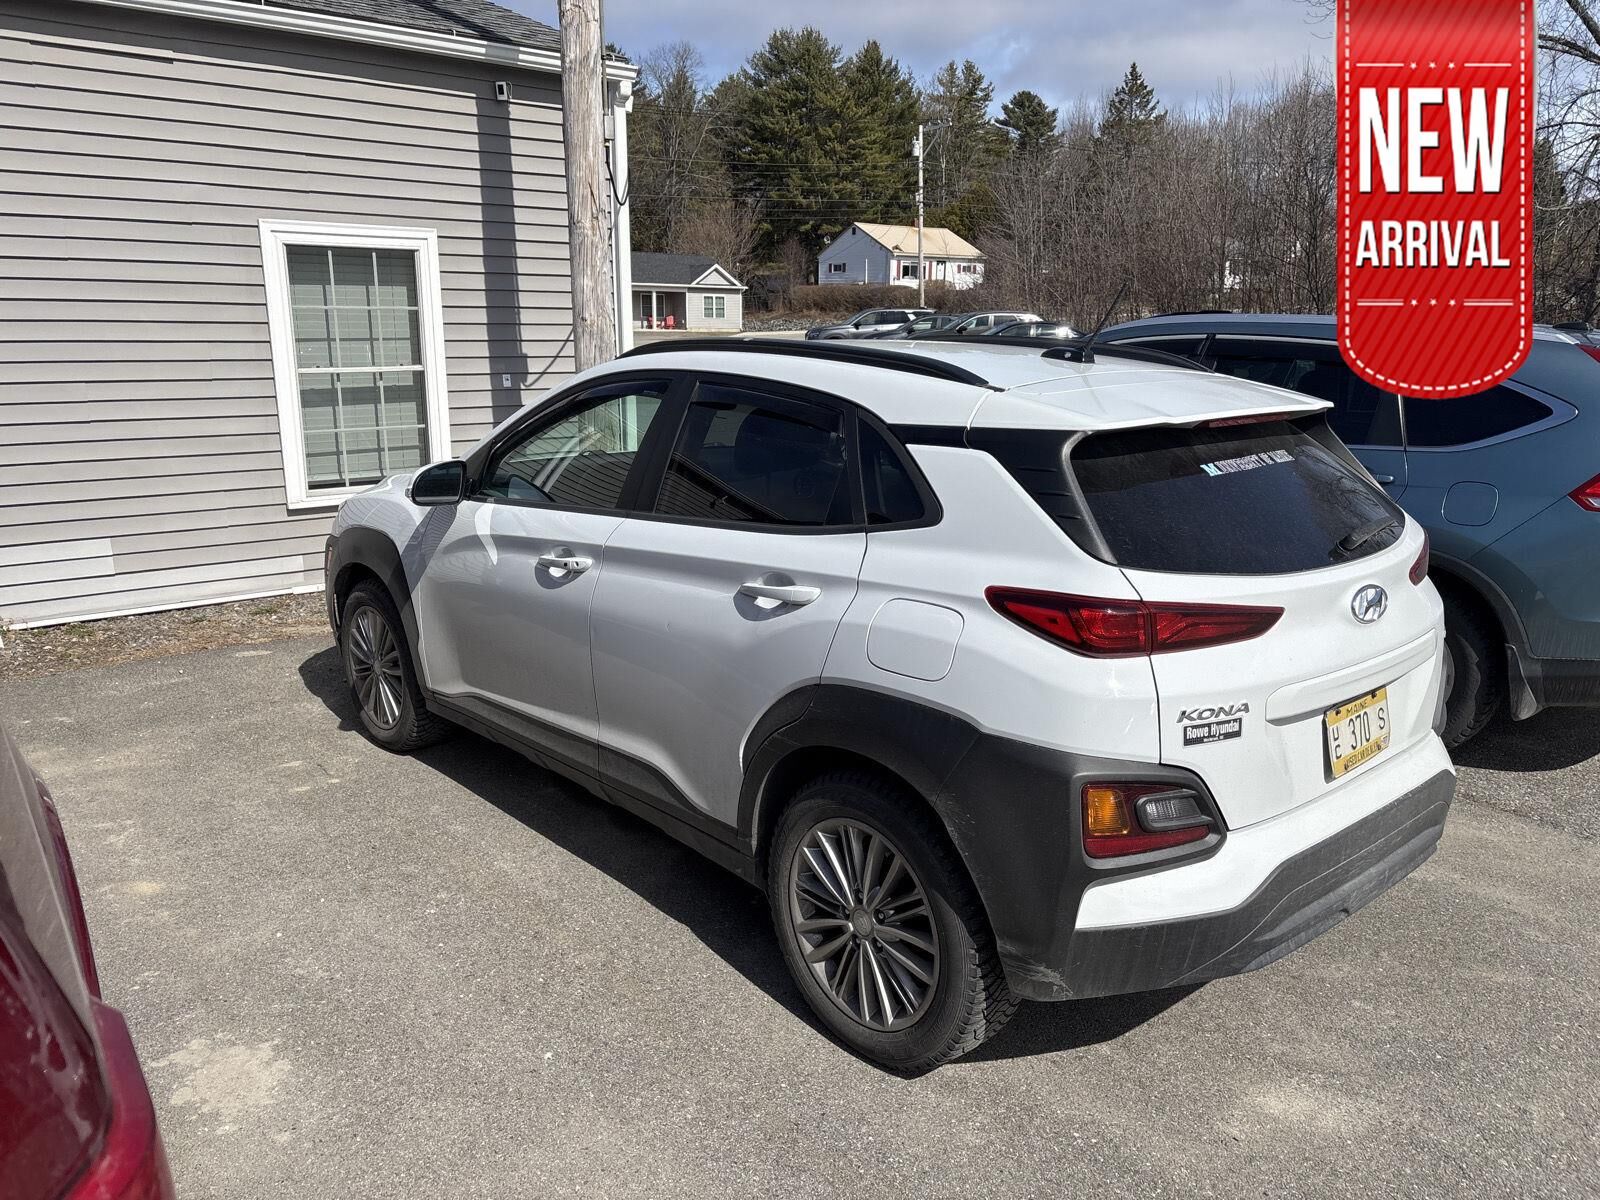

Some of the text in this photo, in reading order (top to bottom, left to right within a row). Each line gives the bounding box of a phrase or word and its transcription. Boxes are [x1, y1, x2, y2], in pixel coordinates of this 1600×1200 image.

[1176, 702, 1250, 724] KONA
[1346, 699, 1368, 716] MAINE
[1186, 726, 1209, 740] Rowe
[1210, 719, 1240, 737] Hyundai
[1348, 707, 1386, 751] 370 S
